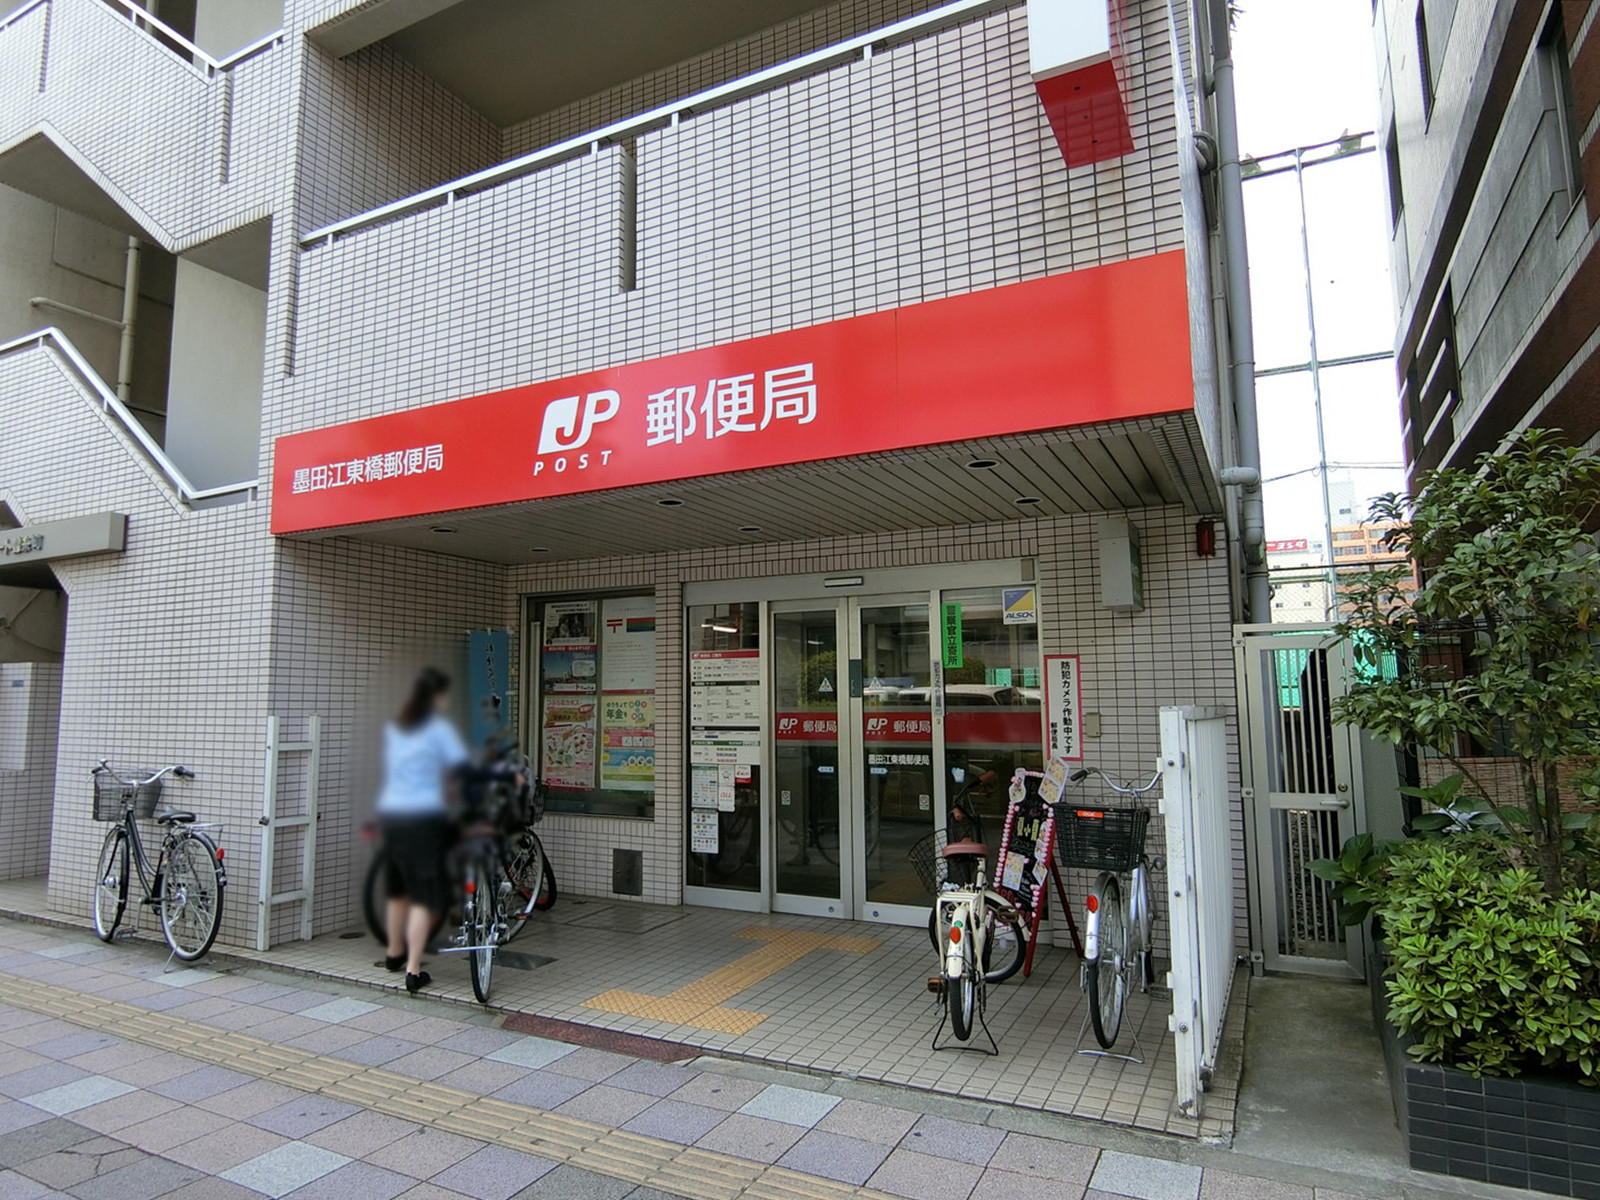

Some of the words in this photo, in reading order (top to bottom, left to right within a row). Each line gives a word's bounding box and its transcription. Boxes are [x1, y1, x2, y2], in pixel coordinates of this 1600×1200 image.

[537, 389, 620, 455] JP
[646, 362, 818, 447] 郵便局
[292, 444, 444, 494] 墨田江東橋郵便局
[533, 450, 613, 476] POST
[1061, 661, 1073, 754] 防犯カメラ作動中です
[779, 718, 798, 730] JP
[803, 720, 837, 732] 郵便局
[867, 718, 888, 731] JP
[893, 720, 931, 733] 郵便局
[1050, 722, 1058, 749] 郵便局長
